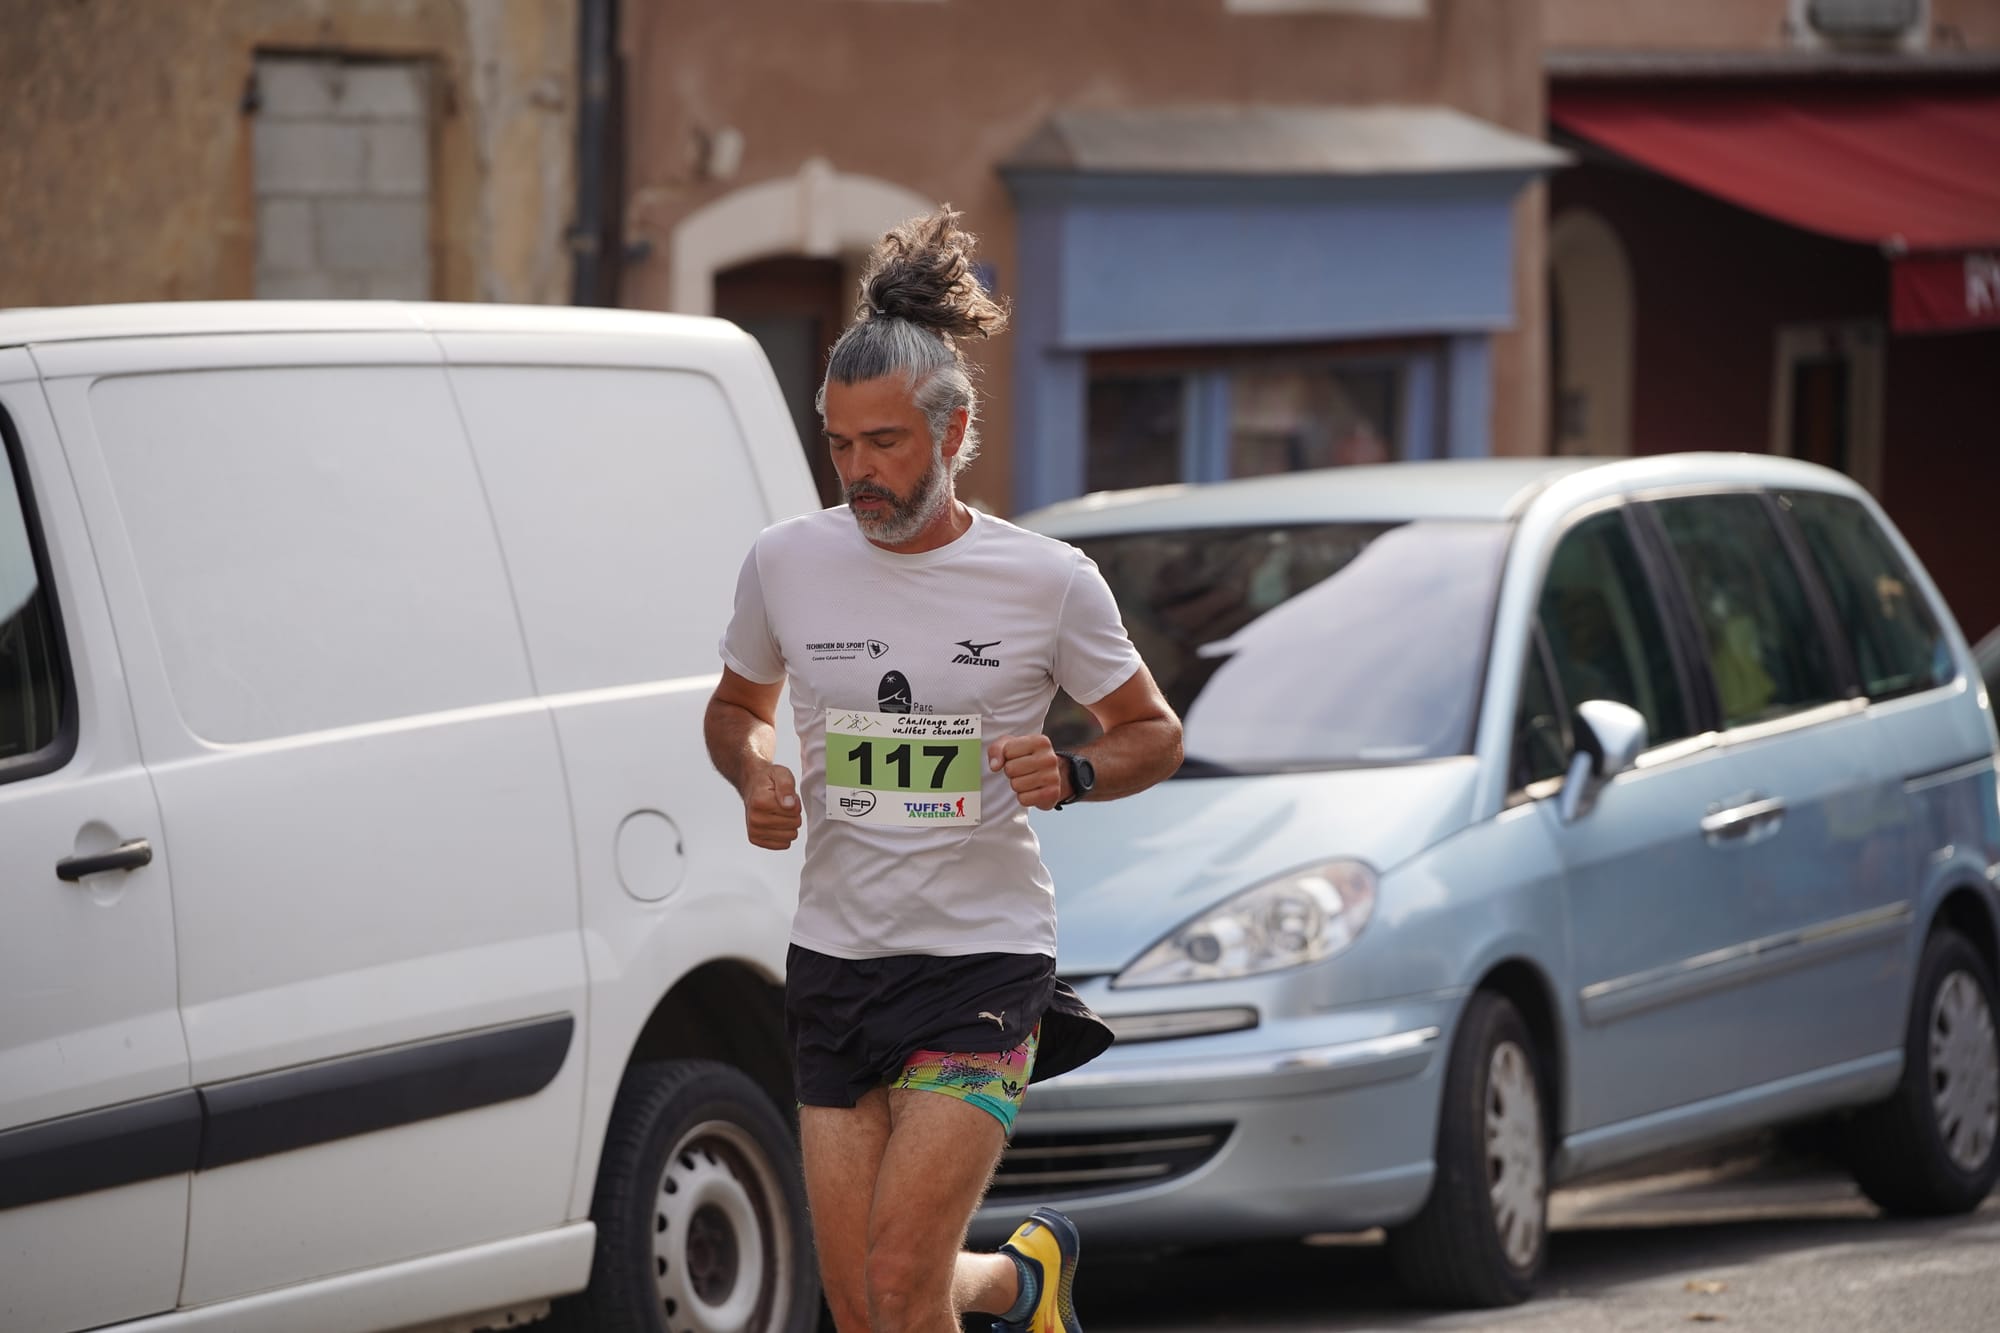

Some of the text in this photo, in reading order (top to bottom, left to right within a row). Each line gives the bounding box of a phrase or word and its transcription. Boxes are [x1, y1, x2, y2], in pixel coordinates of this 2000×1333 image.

[951, 654, 1000, 667] MIZUNO
[913, 702, 933, 713] Parc
[897, 716, 970, 729] Challenge des
[892, 726, 974, 736] vallées cévenoles
[848, 741, 959, 789] 117
[840, 797, 871, 809] BFP
[904, 802, 951, 812] TUFF'S
[908, 810, 956, 818] Aventure
